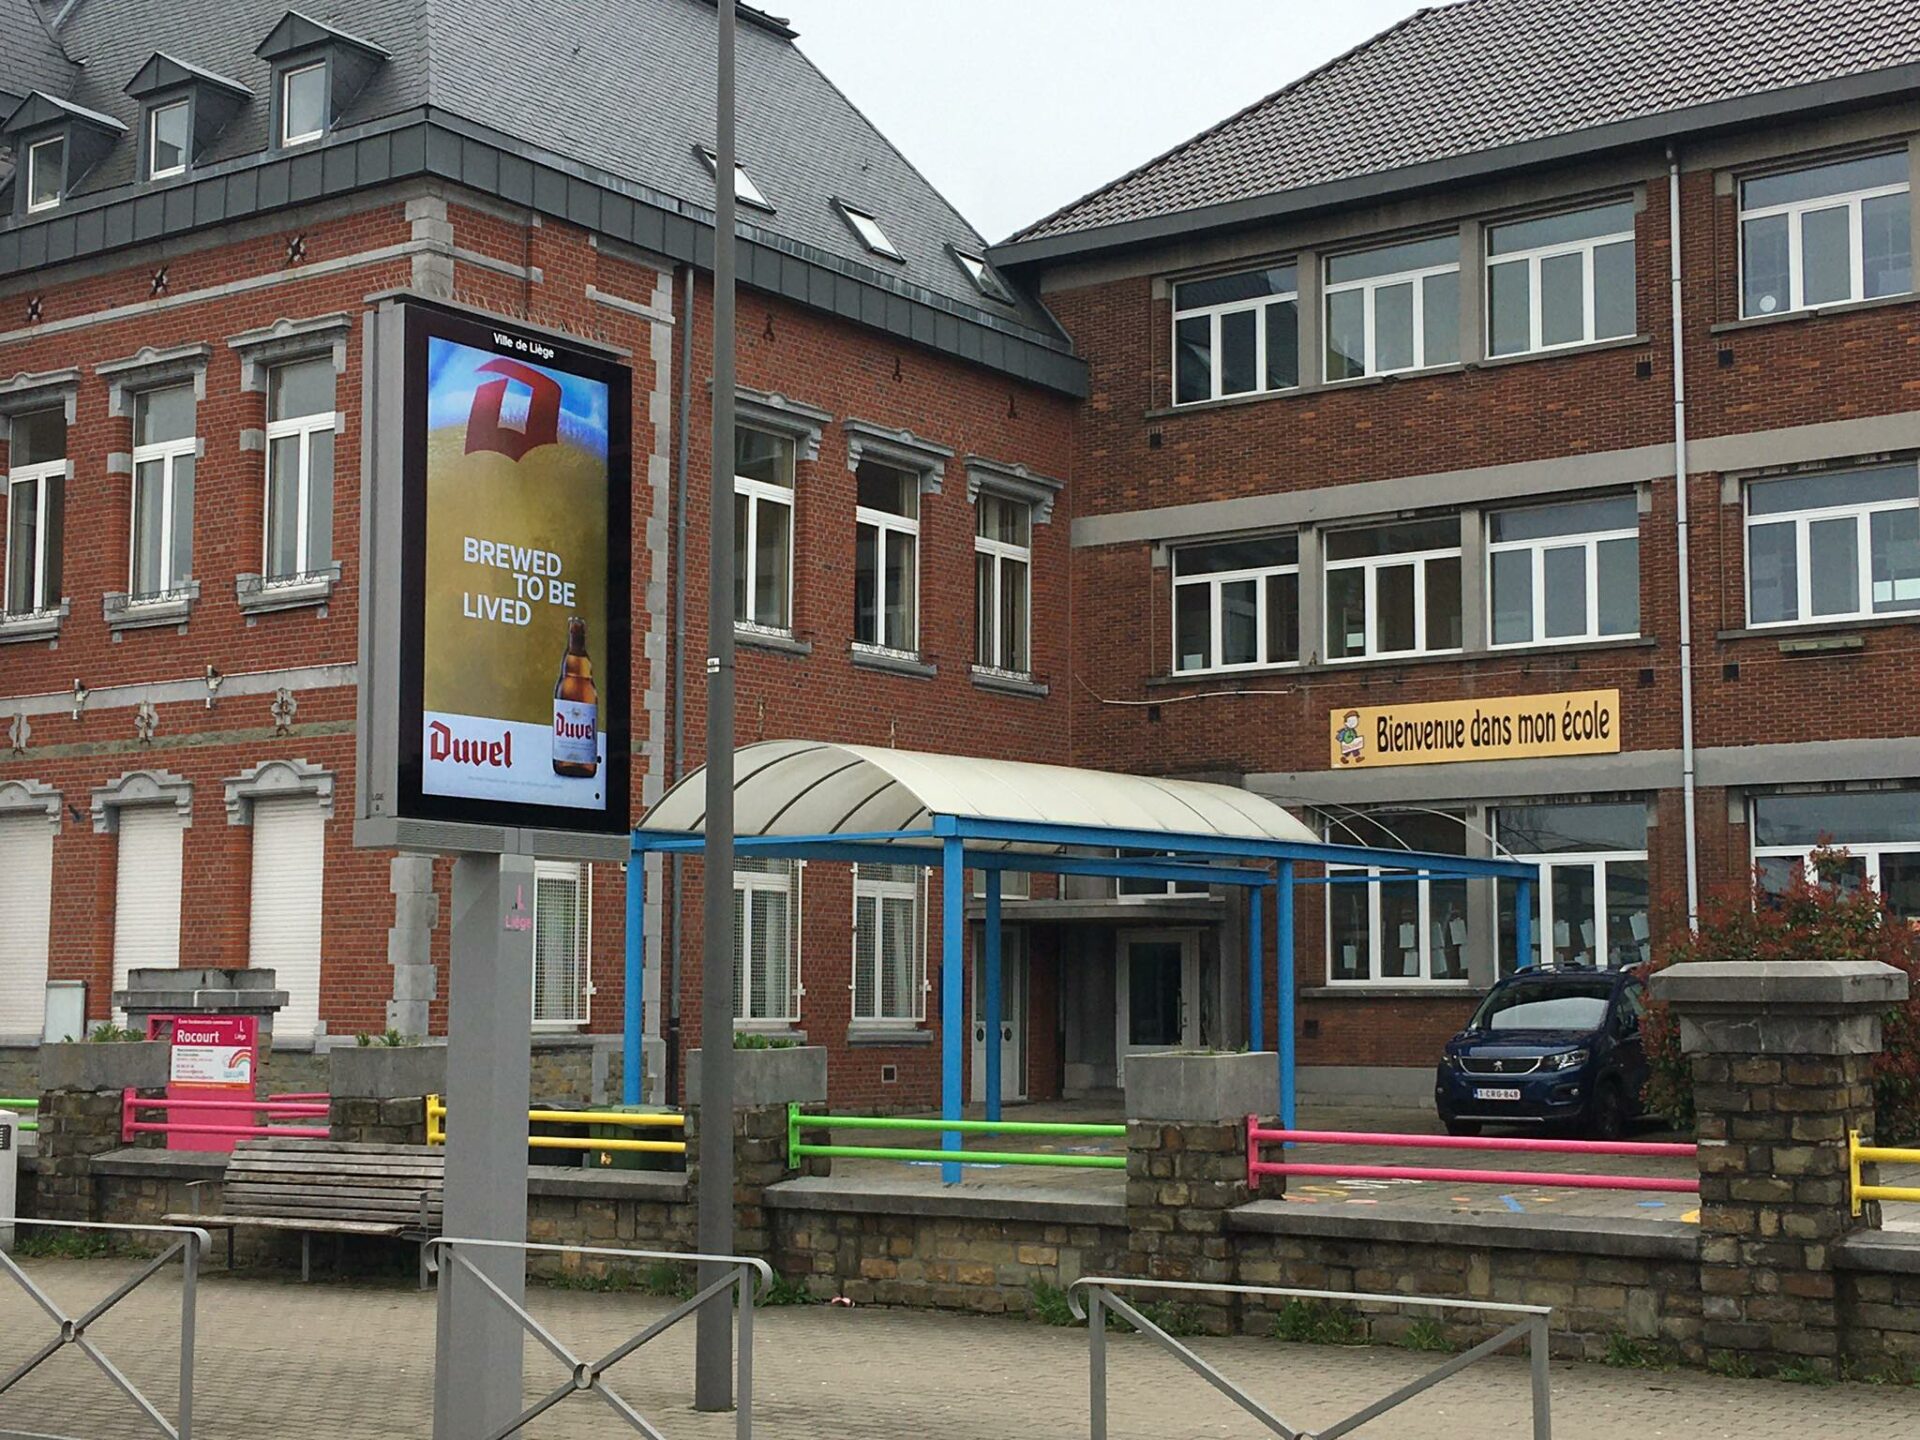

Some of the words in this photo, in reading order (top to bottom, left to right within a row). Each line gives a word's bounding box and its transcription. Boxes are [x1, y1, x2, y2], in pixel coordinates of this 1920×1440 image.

[493, 332, 513, 348] Ville
[515, 339, 528, 351] de
[529, 342, 555, 360] Liège
[463, 536, 562, 577] BREWED
[513, 573, 545, 601] TO
[548, 580, 576, 607] BE
[463, 592, 532, 626] LIVED
[555, 712, 596, 740] Duvel
[1376, 715, 1465, 753] Bienvenue
[1470, 709, 1512, 748] dans
[1517, 711, 1556, 745] mon
[1561, 700, 1610, 742] école
[428, 720, 513, 769] Duvel
[505, 914, 532, 931] Liège
[177, 1029, 220, 1043] Rocourt
